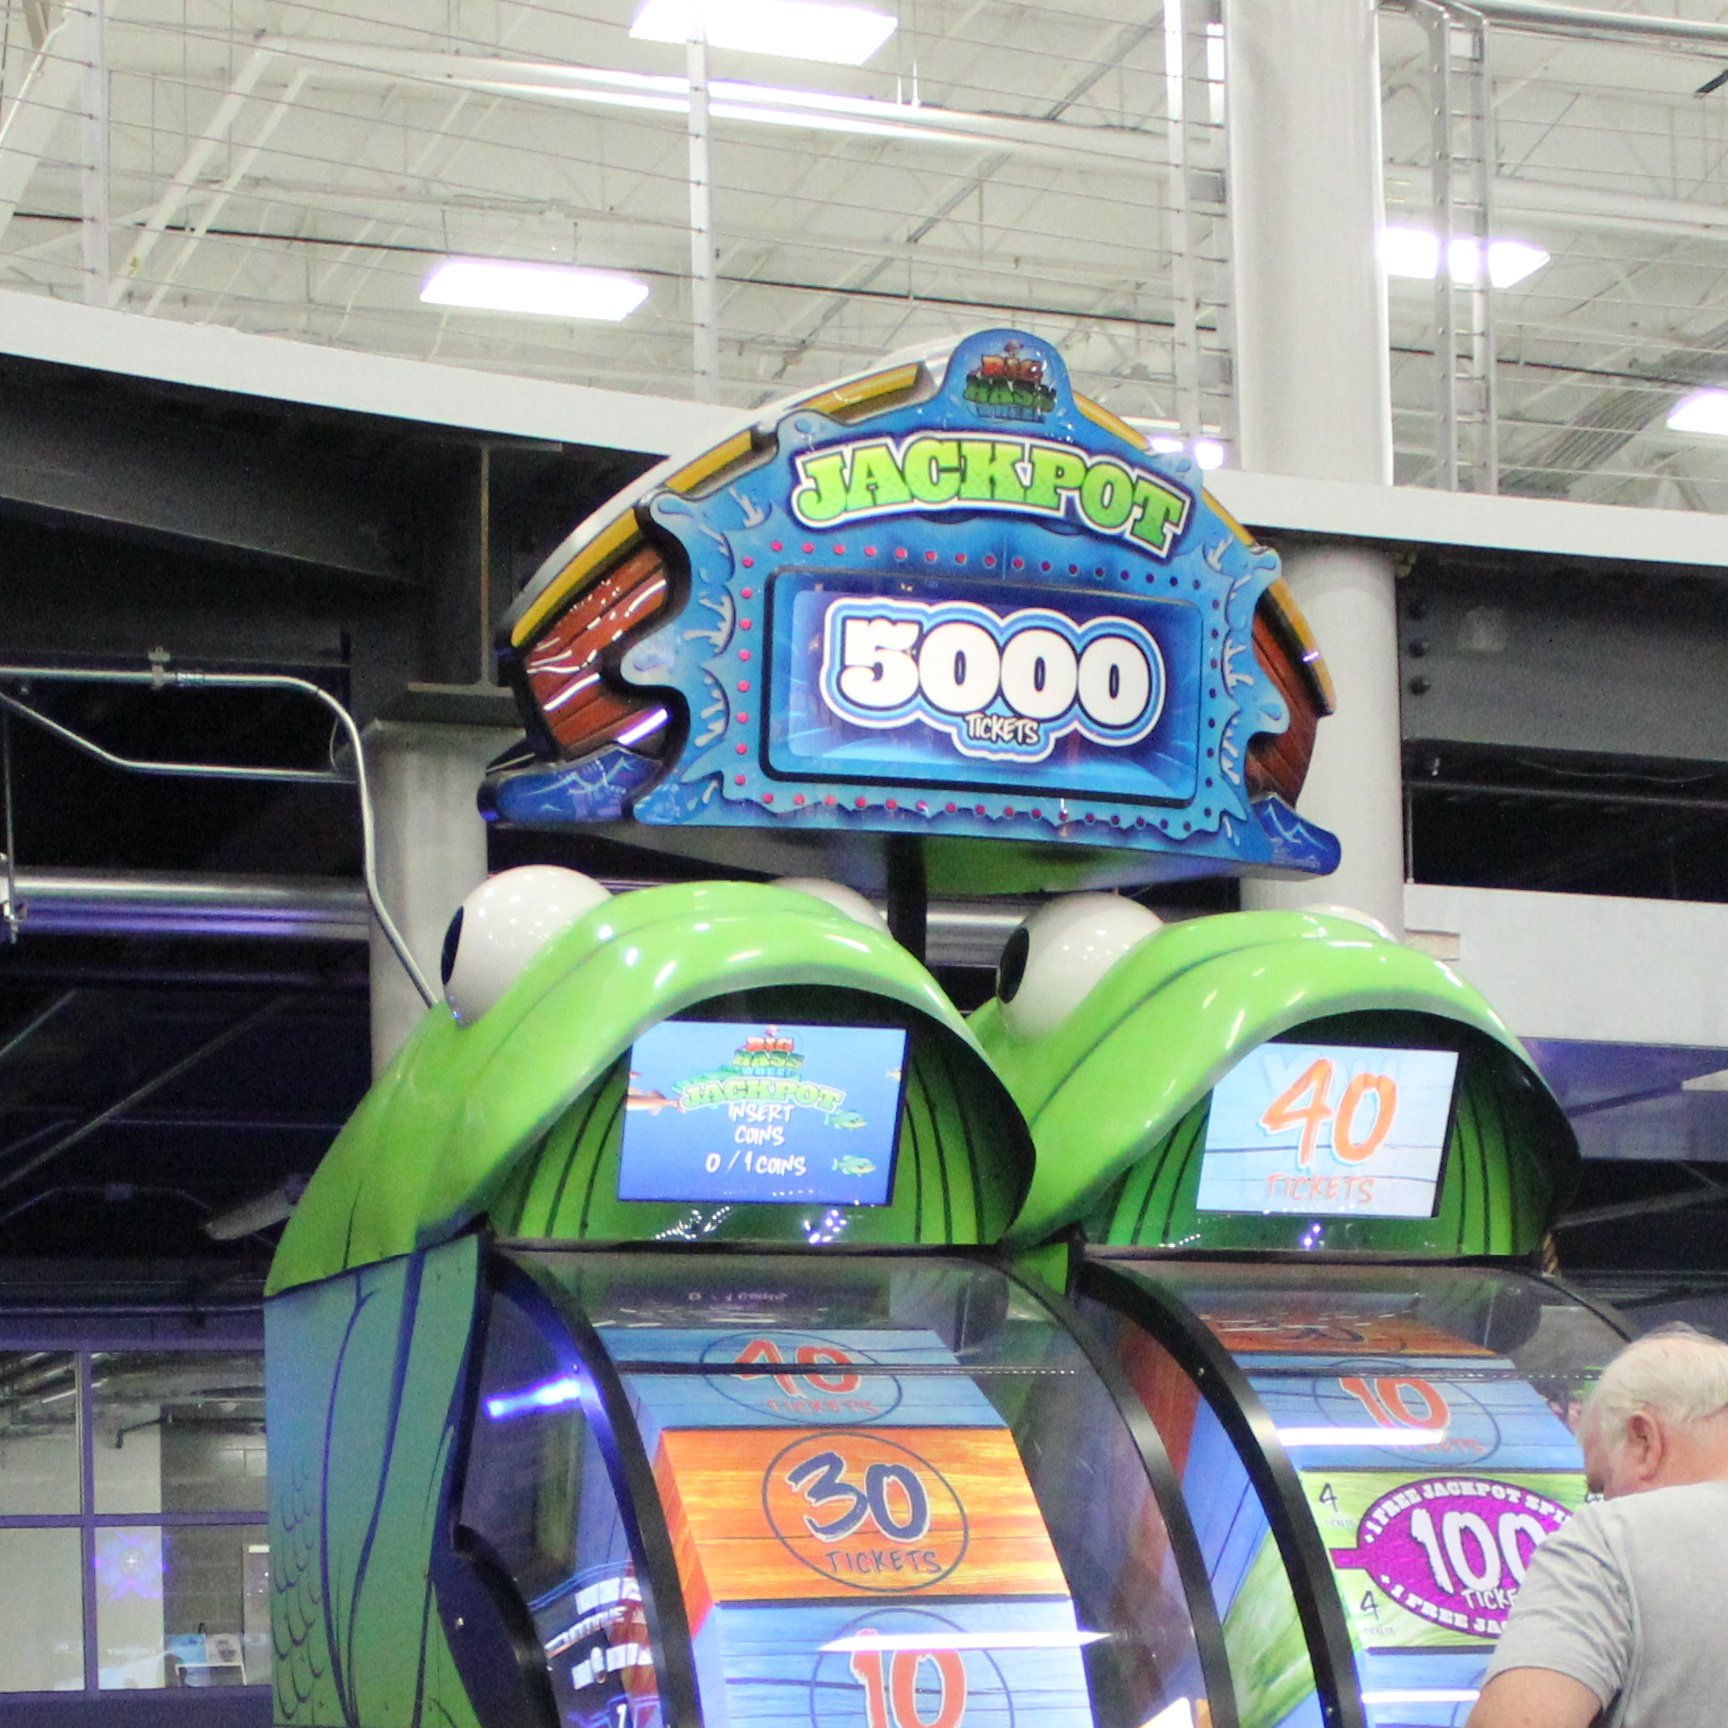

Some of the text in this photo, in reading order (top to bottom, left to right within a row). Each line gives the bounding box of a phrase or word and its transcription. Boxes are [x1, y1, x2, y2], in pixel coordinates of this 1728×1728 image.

[794, 434, 1188, 551] JACKPOT
[838, 616, 1151, 728] 5000
[964, 712, 1040, 745] TICKETS
[732, 1049, 805, 1069] BASS
[745, 1036, 795, 1052] BIG
[682, 1078, 845, 1112] JACKPOT
[728, 1102, 795, 1122] INSERT
[1259, 1058, 1398, 1169] 40
[734, 1126, 784, 1146] COINS
[705, 1153, 721, 1173] 0
[743, 1151, 752, 1172] 1
[755, 1154, 807, 1176] COINS
[1266, 1173, 1376, 1203] TICKETS
[732, 1338, 862, 1398] 40
[765, 1398, 881, 1416] TICKETS
[1337, 1375, 1451, 1432] 10
[785, 1450, 931, 1544] 30
[1319, 1483, 1338, 1513] 4
[1372, 1488, 1423, 1520] FREE
[1421, 1480, 1522, 1504] JACKPOT
[826, 1549, 943, 1575] TICKETS
[1410, 1507, 1549, 1597] 100
[1360, 1590, 1379, 1621] 4
[1405, 1592, 1471, 1630] FREE
